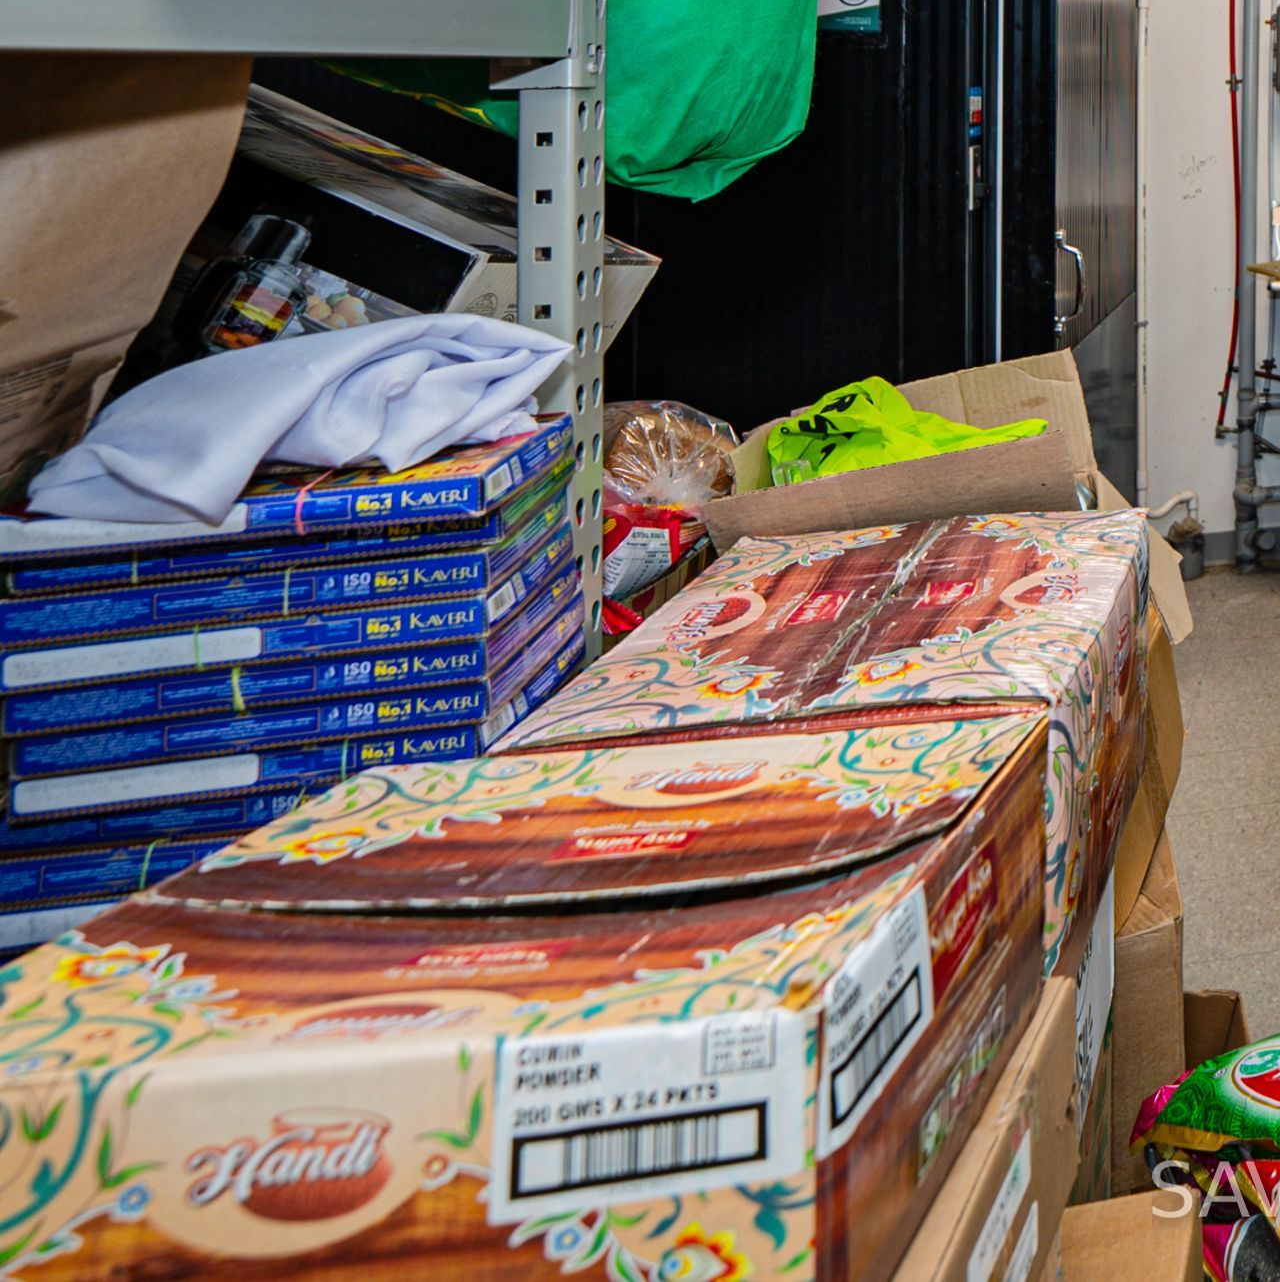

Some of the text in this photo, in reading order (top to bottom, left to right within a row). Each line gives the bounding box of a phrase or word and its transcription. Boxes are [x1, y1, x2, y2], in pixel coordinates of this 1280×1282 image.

[401, 484, 472, 508] KAVERI
[343, 572, 371, 586] ISO
[414, 563, 480, 585] KAVERI
[410, 605, 477, 630] KAVERI
[343, 661, 371, 676] ISO
[413, 652, 479, 674] KAVERI
[347, 702, 375, 717] ISO
[416, 692, 482, 714] KAVERI
[403, 732, 468, 756] KAVERI
[516, 1041, 583, 1067] CUMIN
[513, 1062, 601, 1091] POWDER
[511, 1082, 719, 1128] 200 GMS X 24 PKTS
[193, 1120, 388, 1206] Handi
